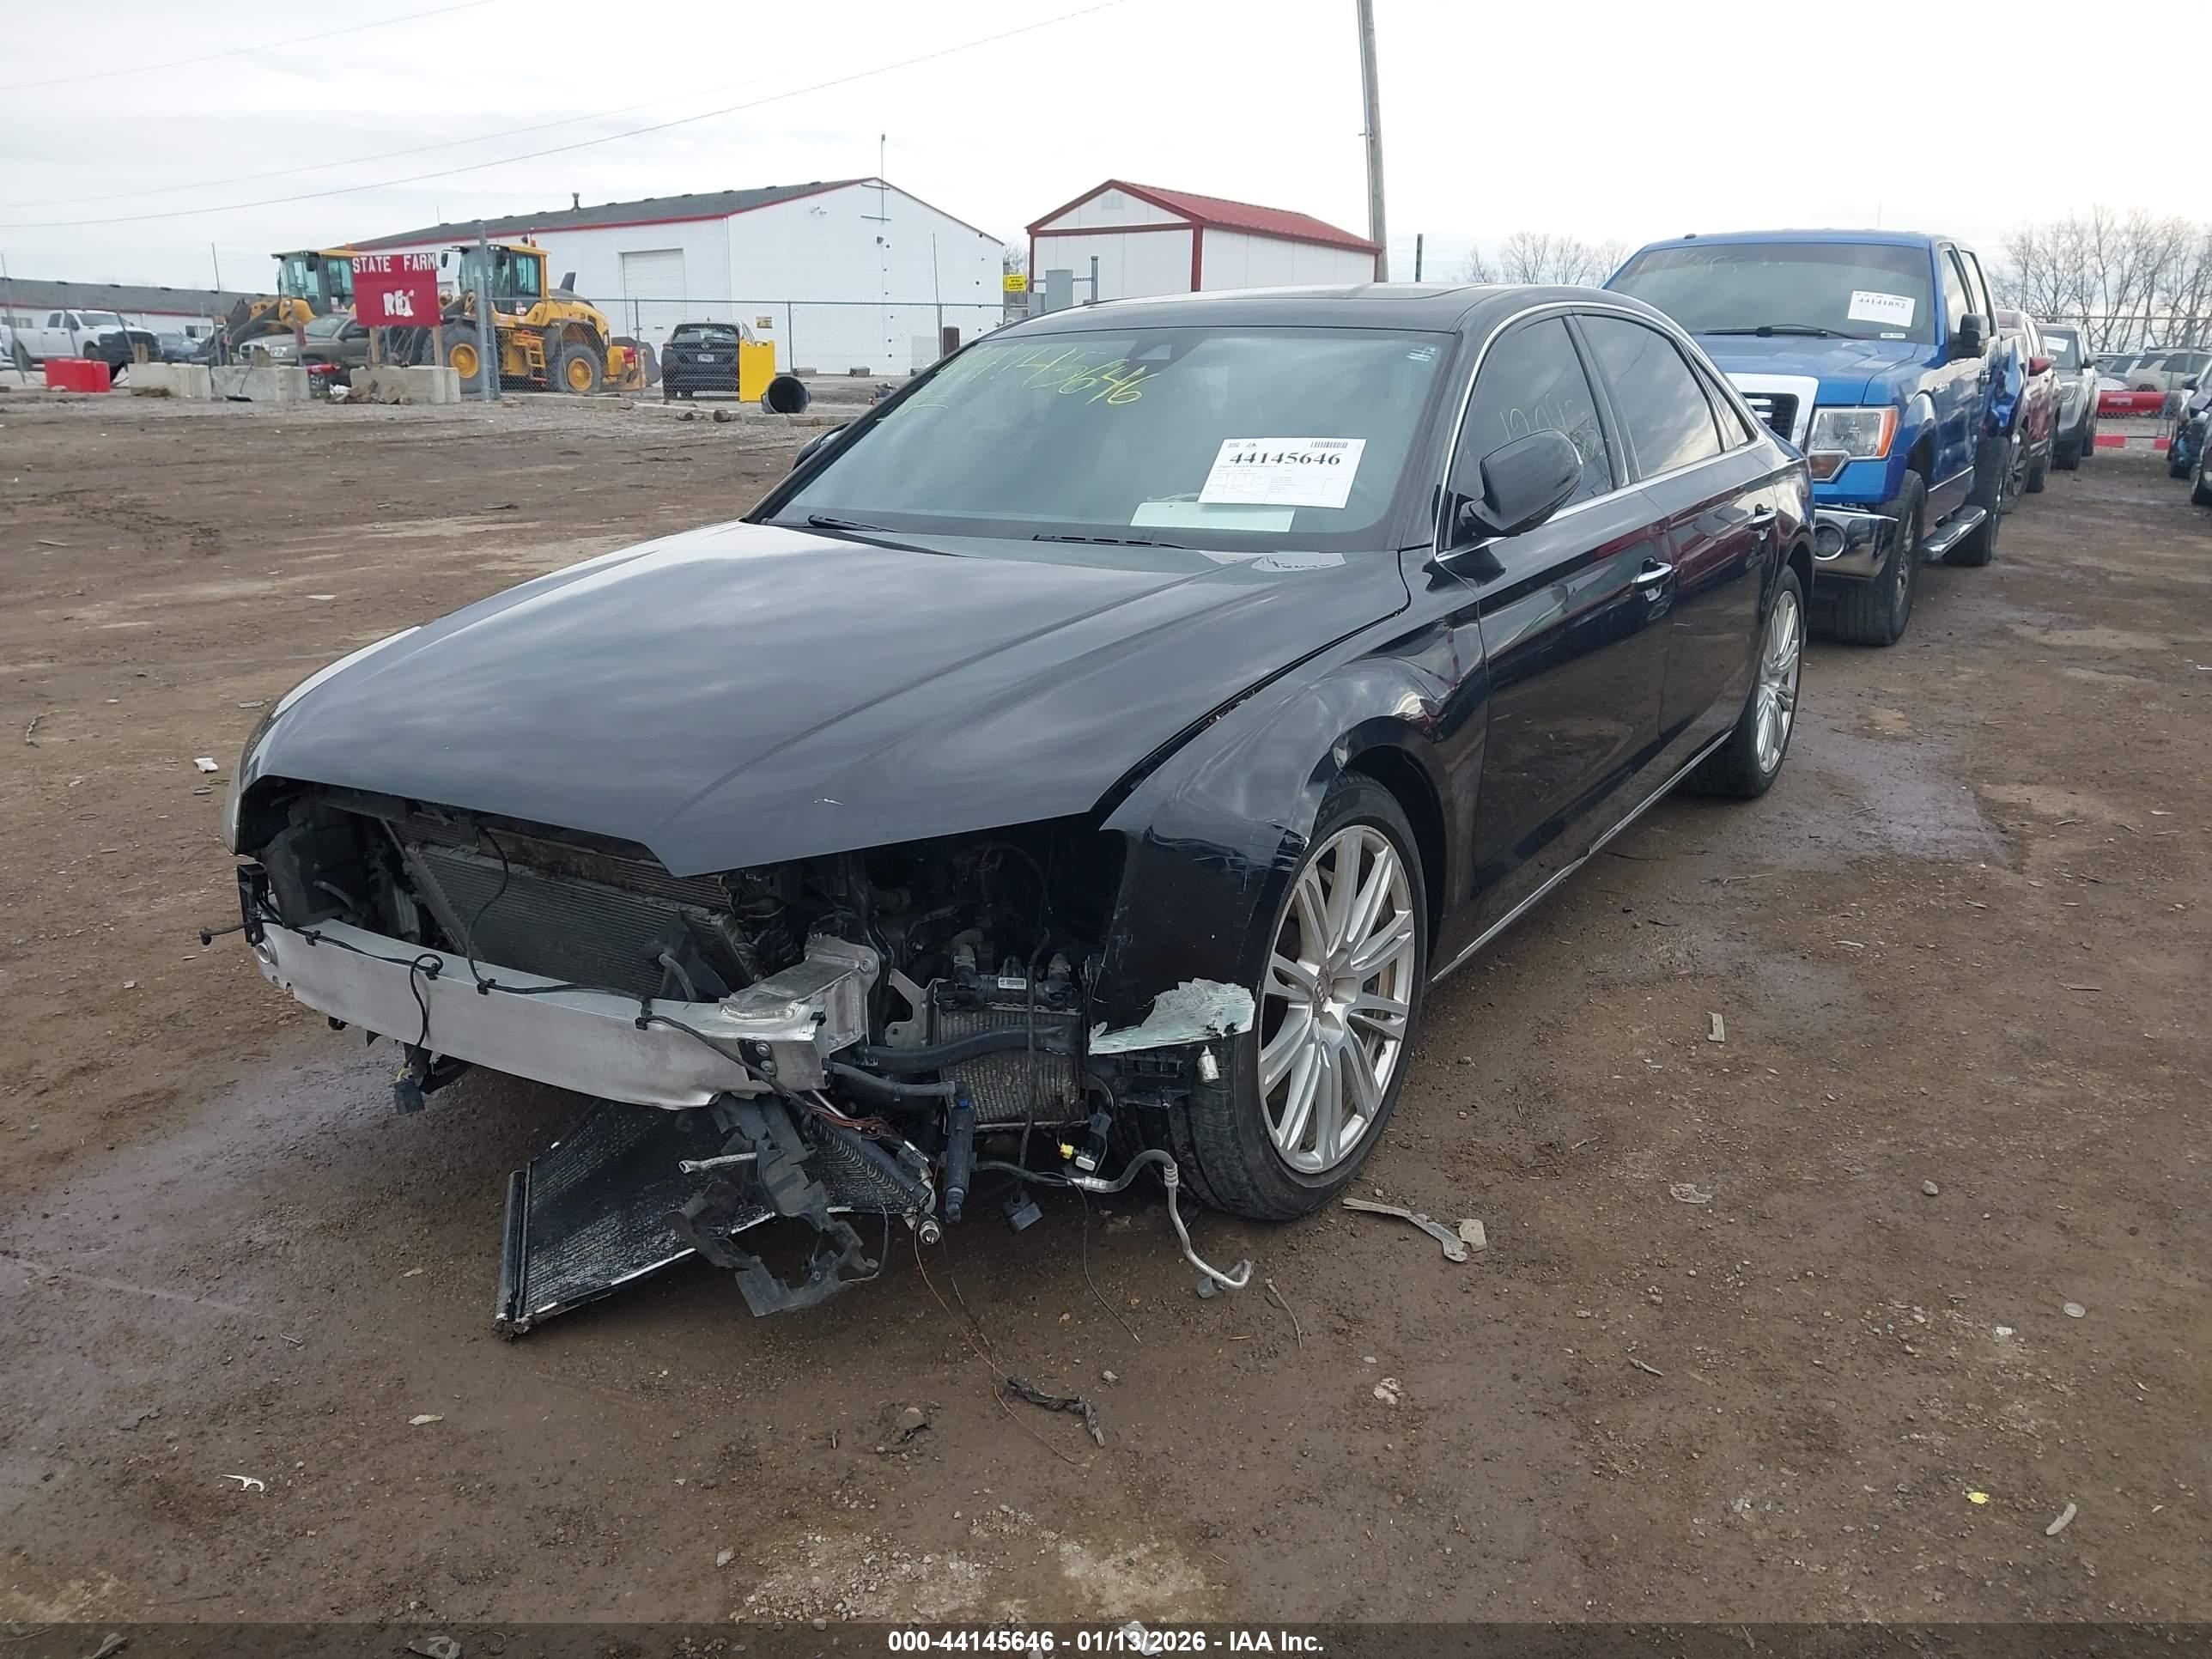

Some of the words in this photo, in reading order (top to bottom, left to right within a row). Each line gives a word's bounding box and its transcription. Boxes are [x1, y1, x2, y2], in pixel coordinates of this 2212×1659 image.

[352, 256, 392, 273] STATE
[404, 253, 435, 271] FARM
[1229, 452, 1342, 465] 44145646
